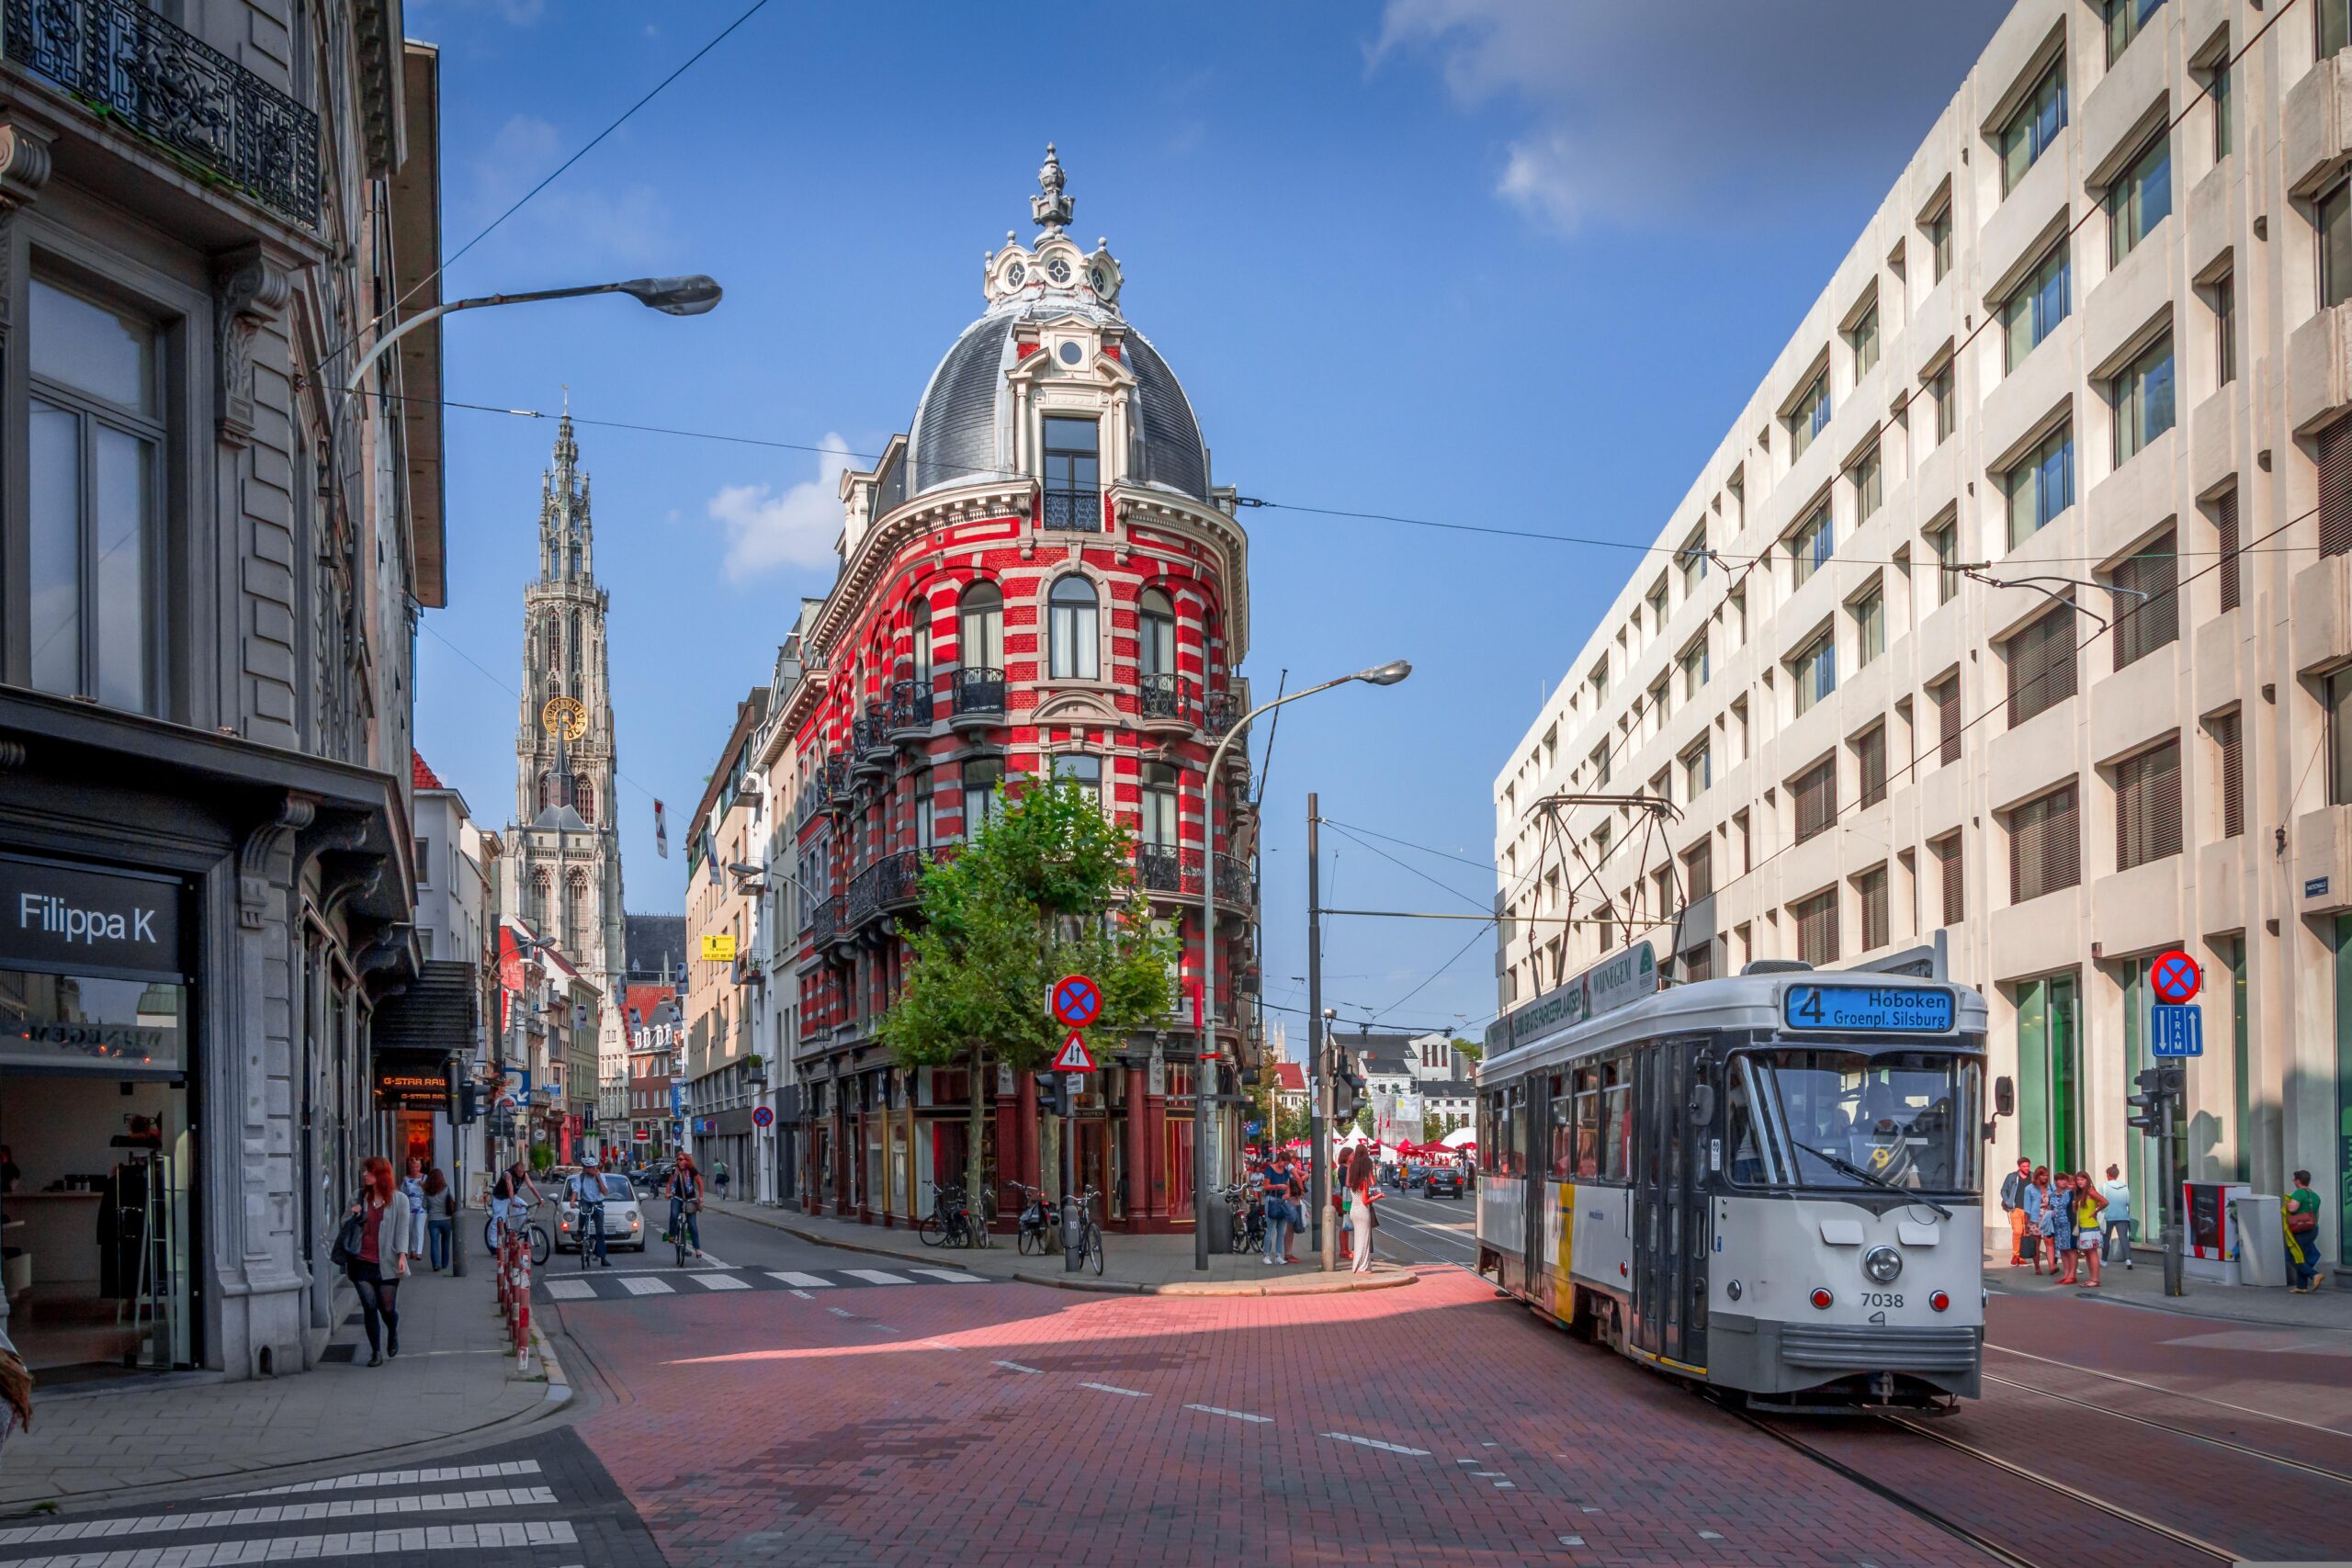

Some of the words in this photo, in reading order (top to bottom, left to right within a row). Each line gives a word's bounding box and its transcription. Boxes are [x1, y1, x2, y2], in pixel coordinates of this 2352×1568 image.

[21, 892, 126, 944] Filippa
[134, 908, 157, 943] K
[1593, 957, 1632, 995] WIJNEGEM
[1799, 991, 1826, 1024] 4
[1869, 993, 1946, 1009] Hoboken
[1834, 1010, 1889, 1029] Groenpl.
[1893, 1011, 1946, 1030] Silsburg
[2174, 1010, 2182, 1050] TRAM
[1069, 1221, 1077, 1229] 10
[1860, 1292, 1905, 1308] 7038
